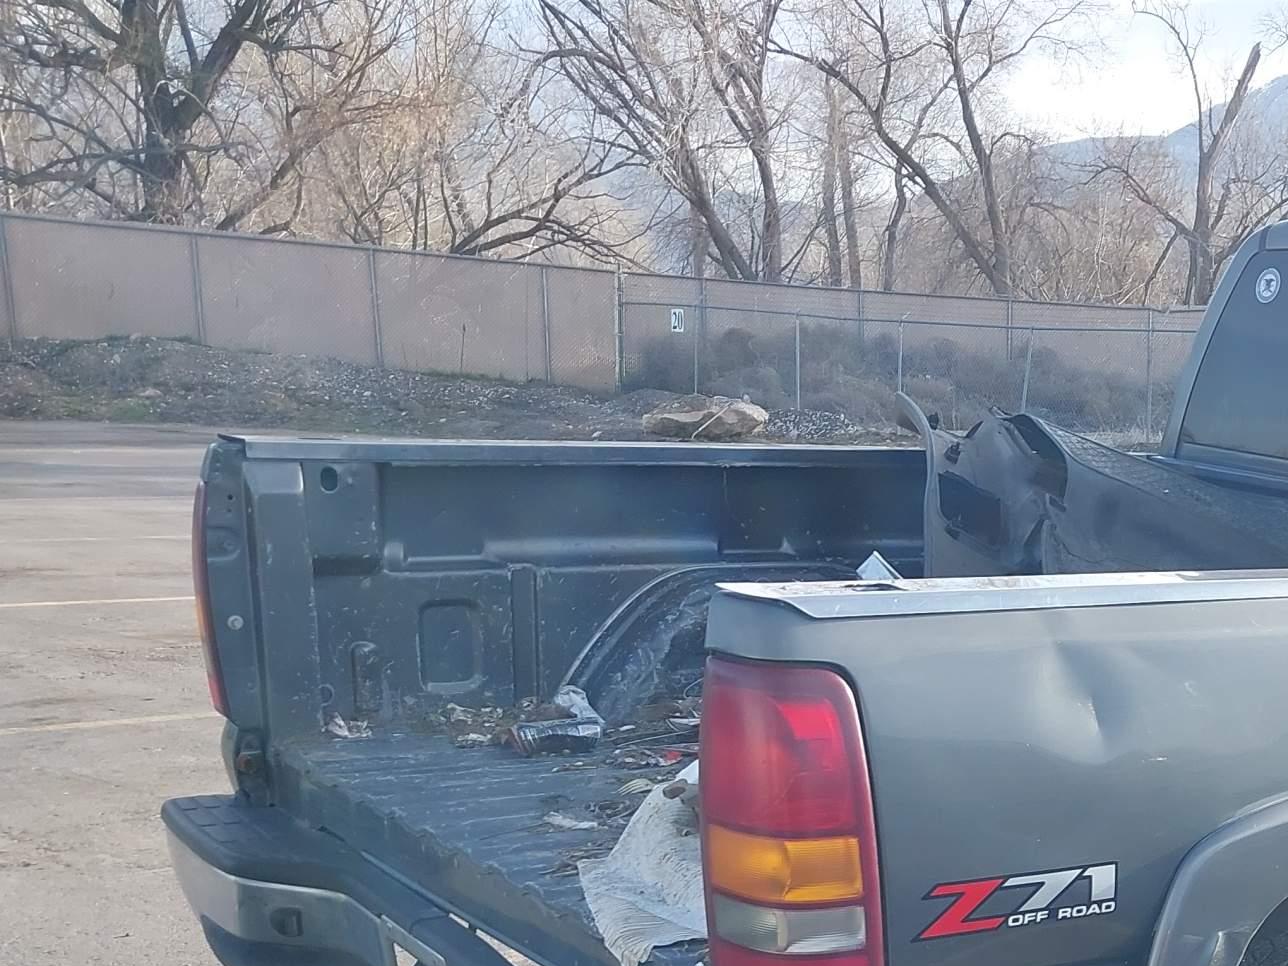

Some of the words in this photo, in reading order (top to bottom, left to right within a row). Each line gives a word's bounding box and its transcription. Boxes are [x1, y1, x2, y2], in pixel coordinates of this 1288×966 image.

[672, 311, 684, 330] 20
[914, 861, 1118, 941] Z71
[1006, 910, 1049, 928] OFF
[1057, 900, 1116, 920] ROAD
